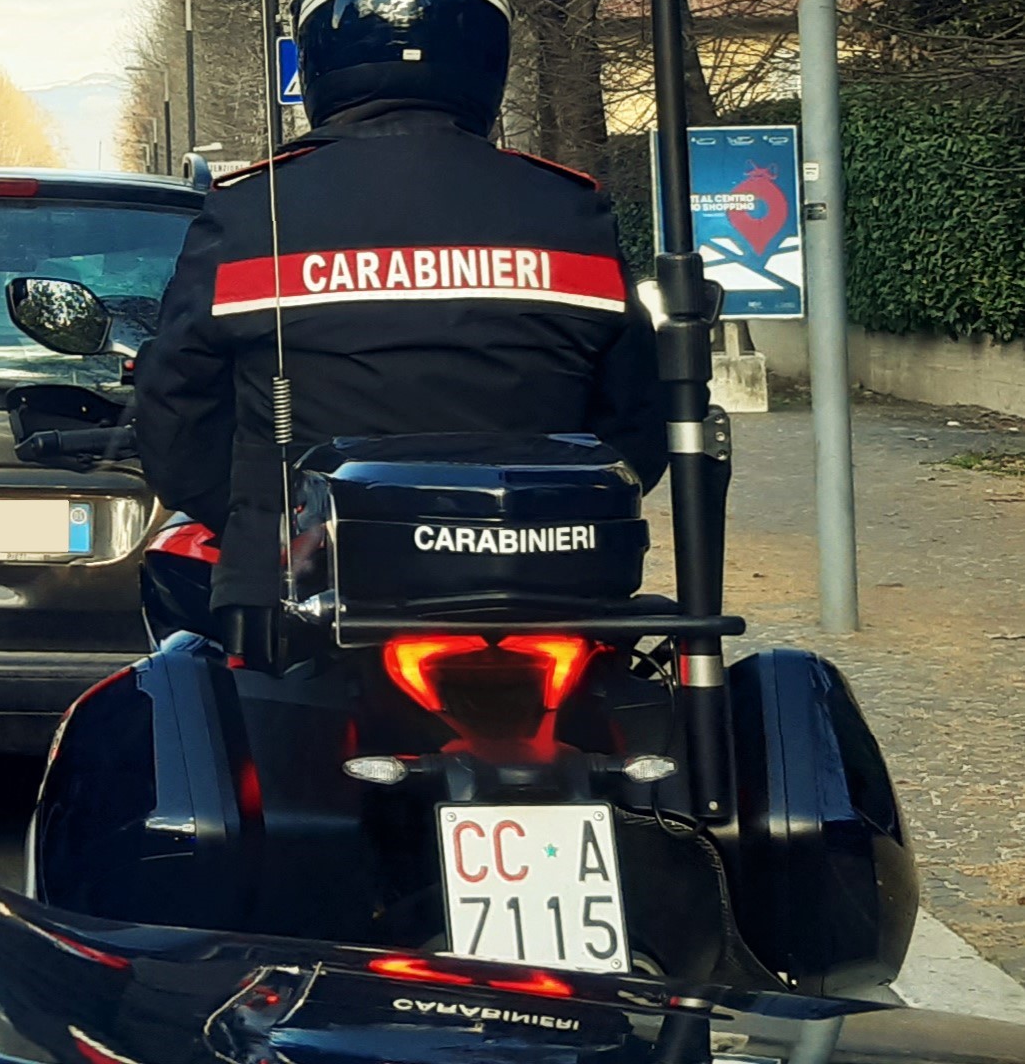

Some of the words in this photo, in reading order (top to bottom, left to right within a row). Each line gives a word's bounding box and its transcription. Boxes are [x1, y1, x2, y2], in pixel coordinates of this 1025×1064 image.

[303, 249, 551, 292] CARABINIERI
[414, 524, 596, 553] CARABINIERI
[452, 820, 529, 883] CC
[579, 820, 609, 882] A
[459, 896, 618, 960] 7115
